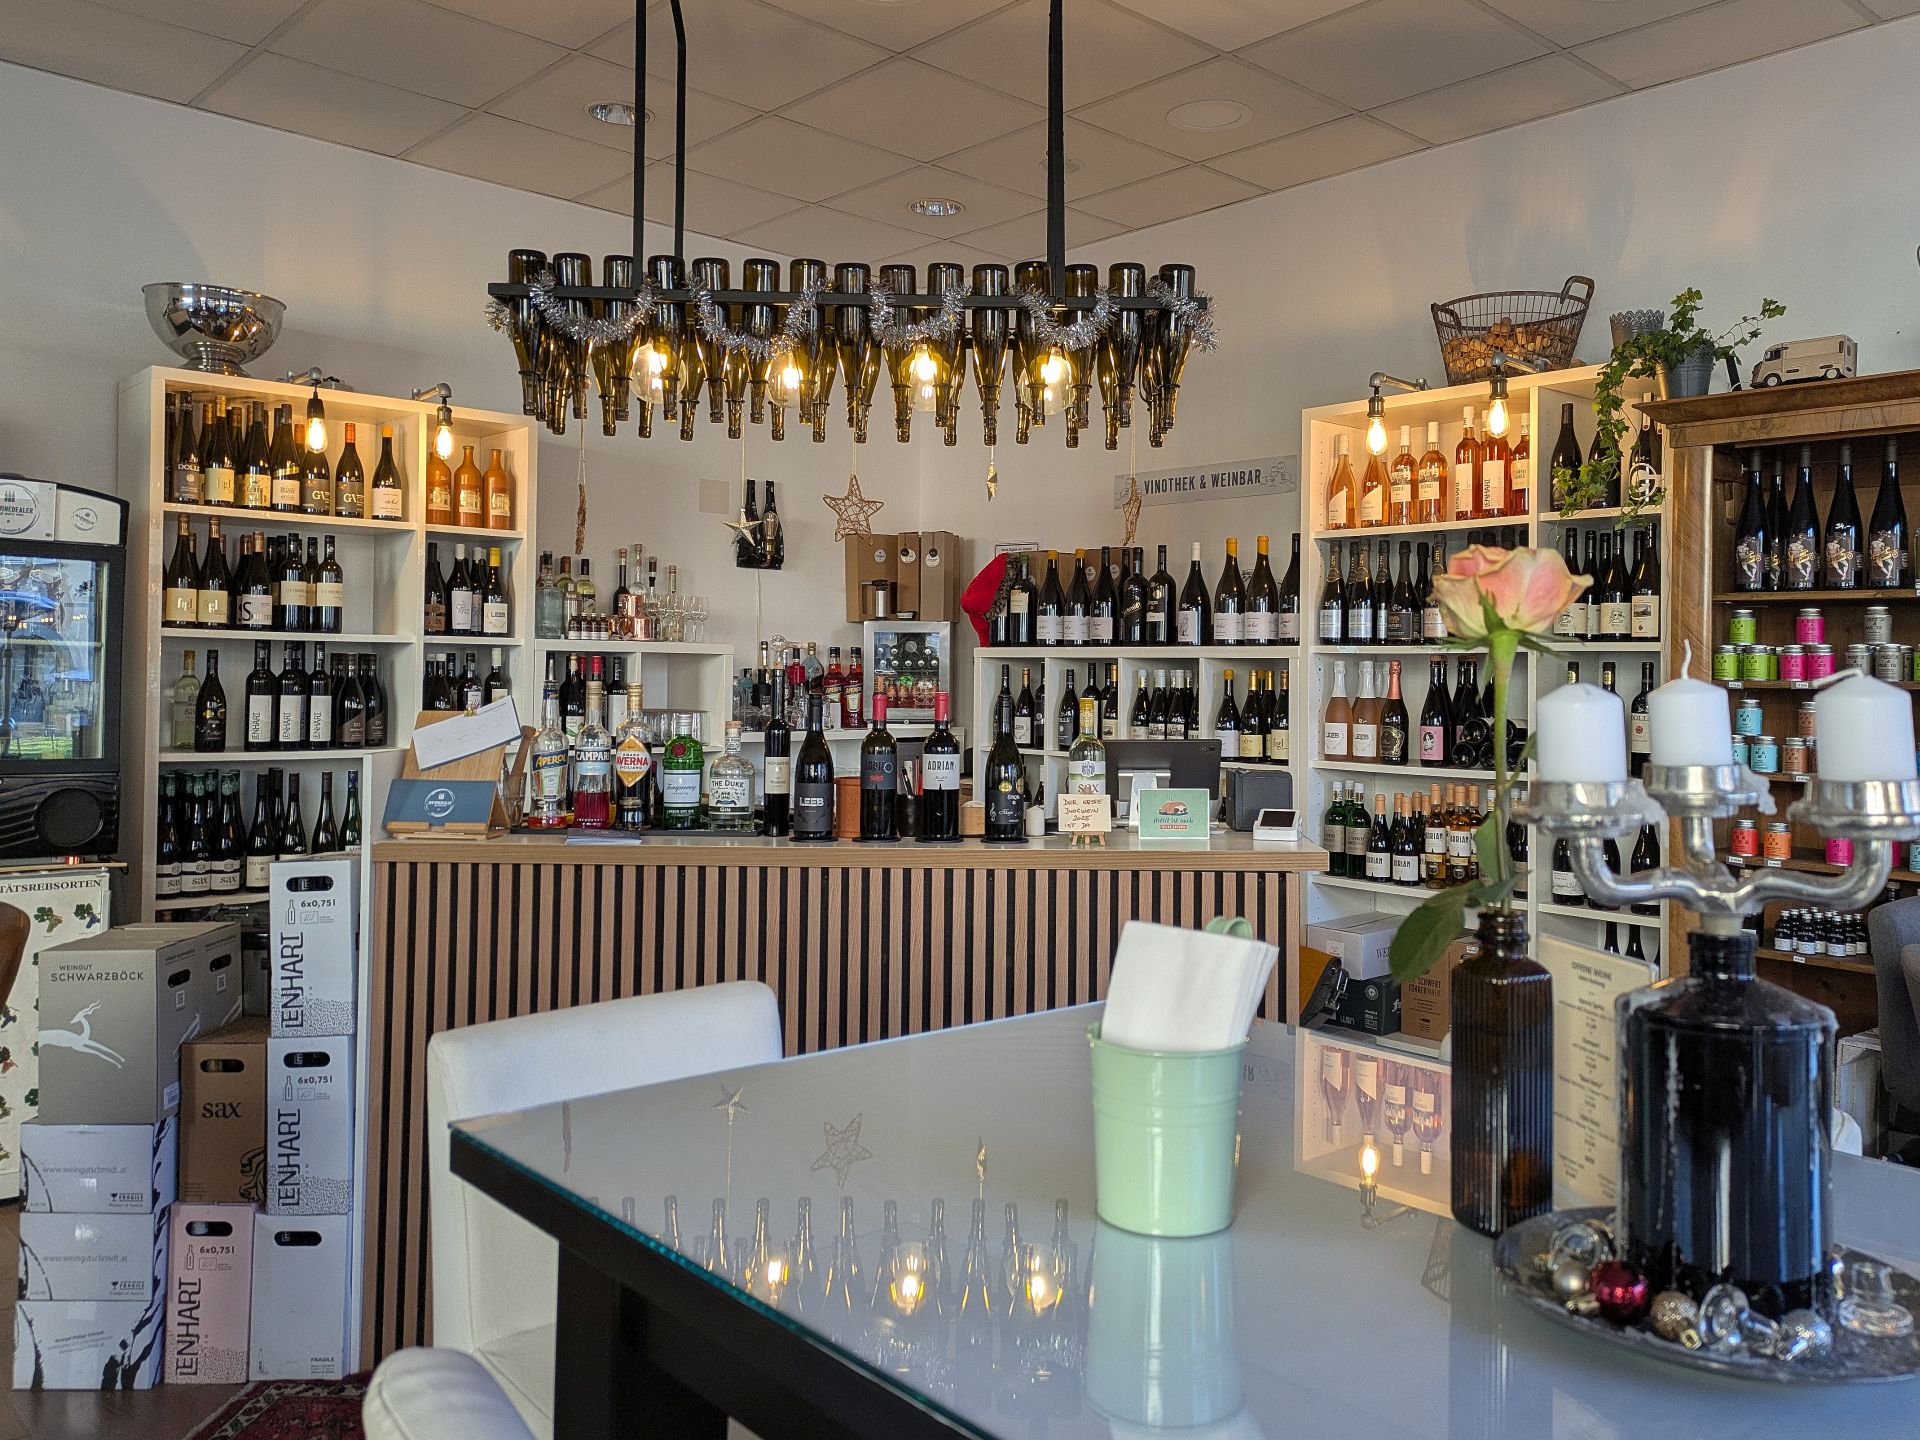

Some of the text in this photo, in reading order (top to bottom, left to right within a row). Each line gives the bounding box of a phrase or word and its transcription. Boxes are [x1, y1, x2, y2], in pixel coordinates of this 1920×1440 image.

[1144, 468, 1262, 494] VINOTHEK & WEINBAR
[928, 760, 955, 771] ADRIAN
[800, 797, 824, 807] LEEB
[51, 970, 144, 982] SCHWARZBÖCK
[202, 1101, 241, 1119] sax
